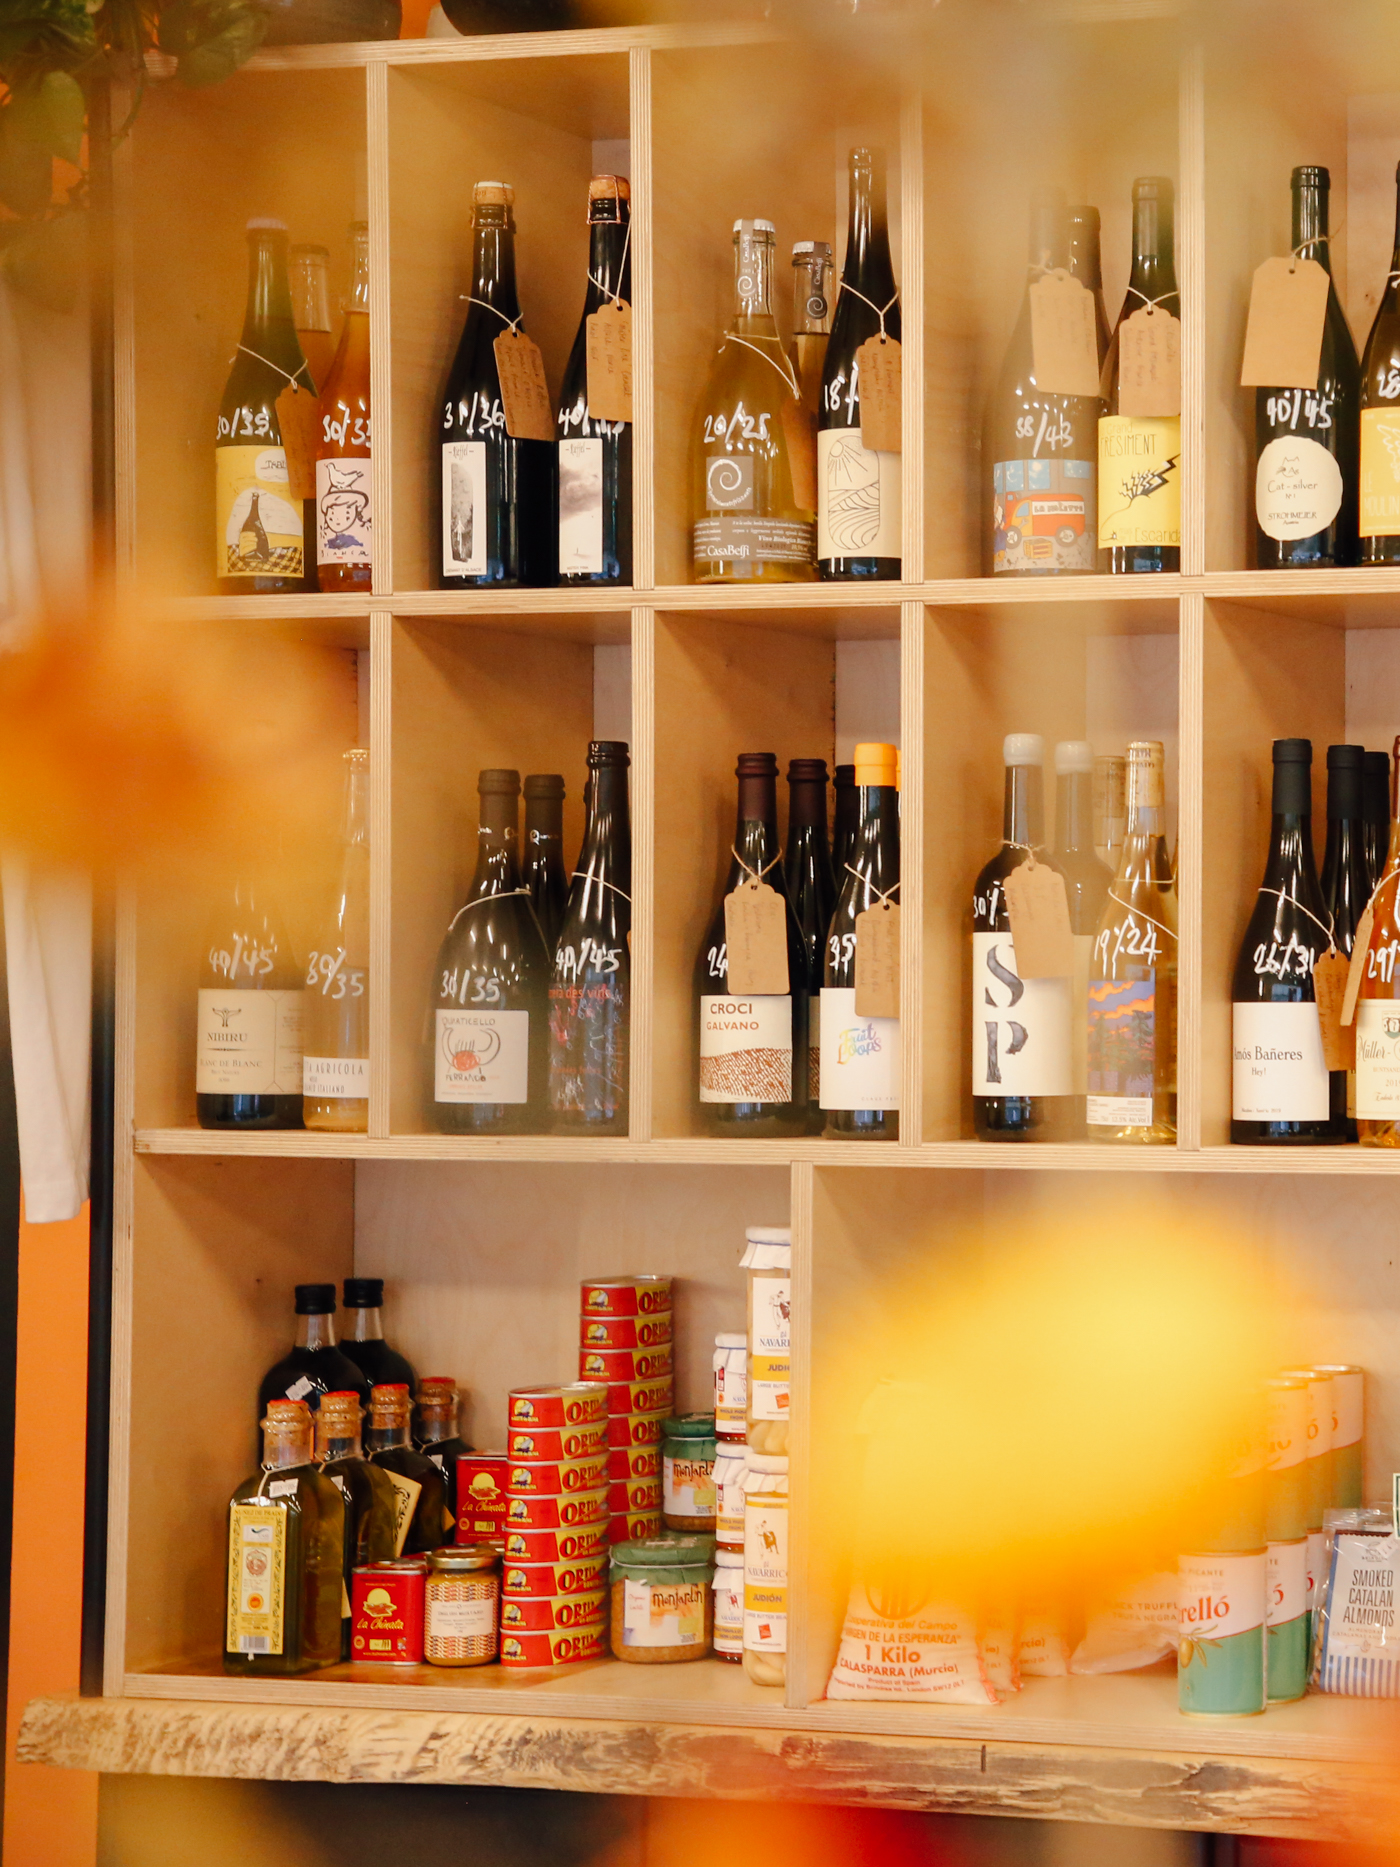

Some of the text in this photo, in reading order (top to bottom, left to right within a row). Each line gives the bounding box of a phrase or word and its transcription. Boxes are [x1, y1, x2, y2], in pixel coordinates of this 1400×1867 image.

[1266, 388, 1334, 430] 40/45
[704, 400, 771, 443] 20/25
[1268, 478, 1318, 493] Cat silver
[973, 887, 1008, 926] 30/
[555, 938, 622, 976] 40/45
[1095, 915, 1162, 980] 19/24
[984, 944, 1024, 1008] S
[440, 968, 500, 1005] 30/35
[710, 1003, 752, 1015] CROCI
[706, 1021, 759, 1031] GALVANO
[207, 1031, 248, 1042] NIBIRU
[985, 1020, 1028, 1084] P
[1255, 1045, 1303, 1061] Bañeres
[316, 1062, 364, 1075] AGRICOLA
[1251, 1067, 1266, 1077] Hey!
[462, 1501, 473, 1511] La
[1352, 1569, 1394, 1588] SMOKED
[753, 1594, 782, 1602] JUDIÓN
[1348, 1588, 1394, 1607] CATALAN
[357, 1616, 404, 1630] La Chinata
[919, 1620, 958, 1630] Campo
[1343, 1606, 1395, 1627] ALMONDS
[869, 1631, 896, 1643] DE LA
[865, 1644, 921, 1663] 1 Kilo
[840, 1657, 959, 1679] CALASPARRA (Murcia)
